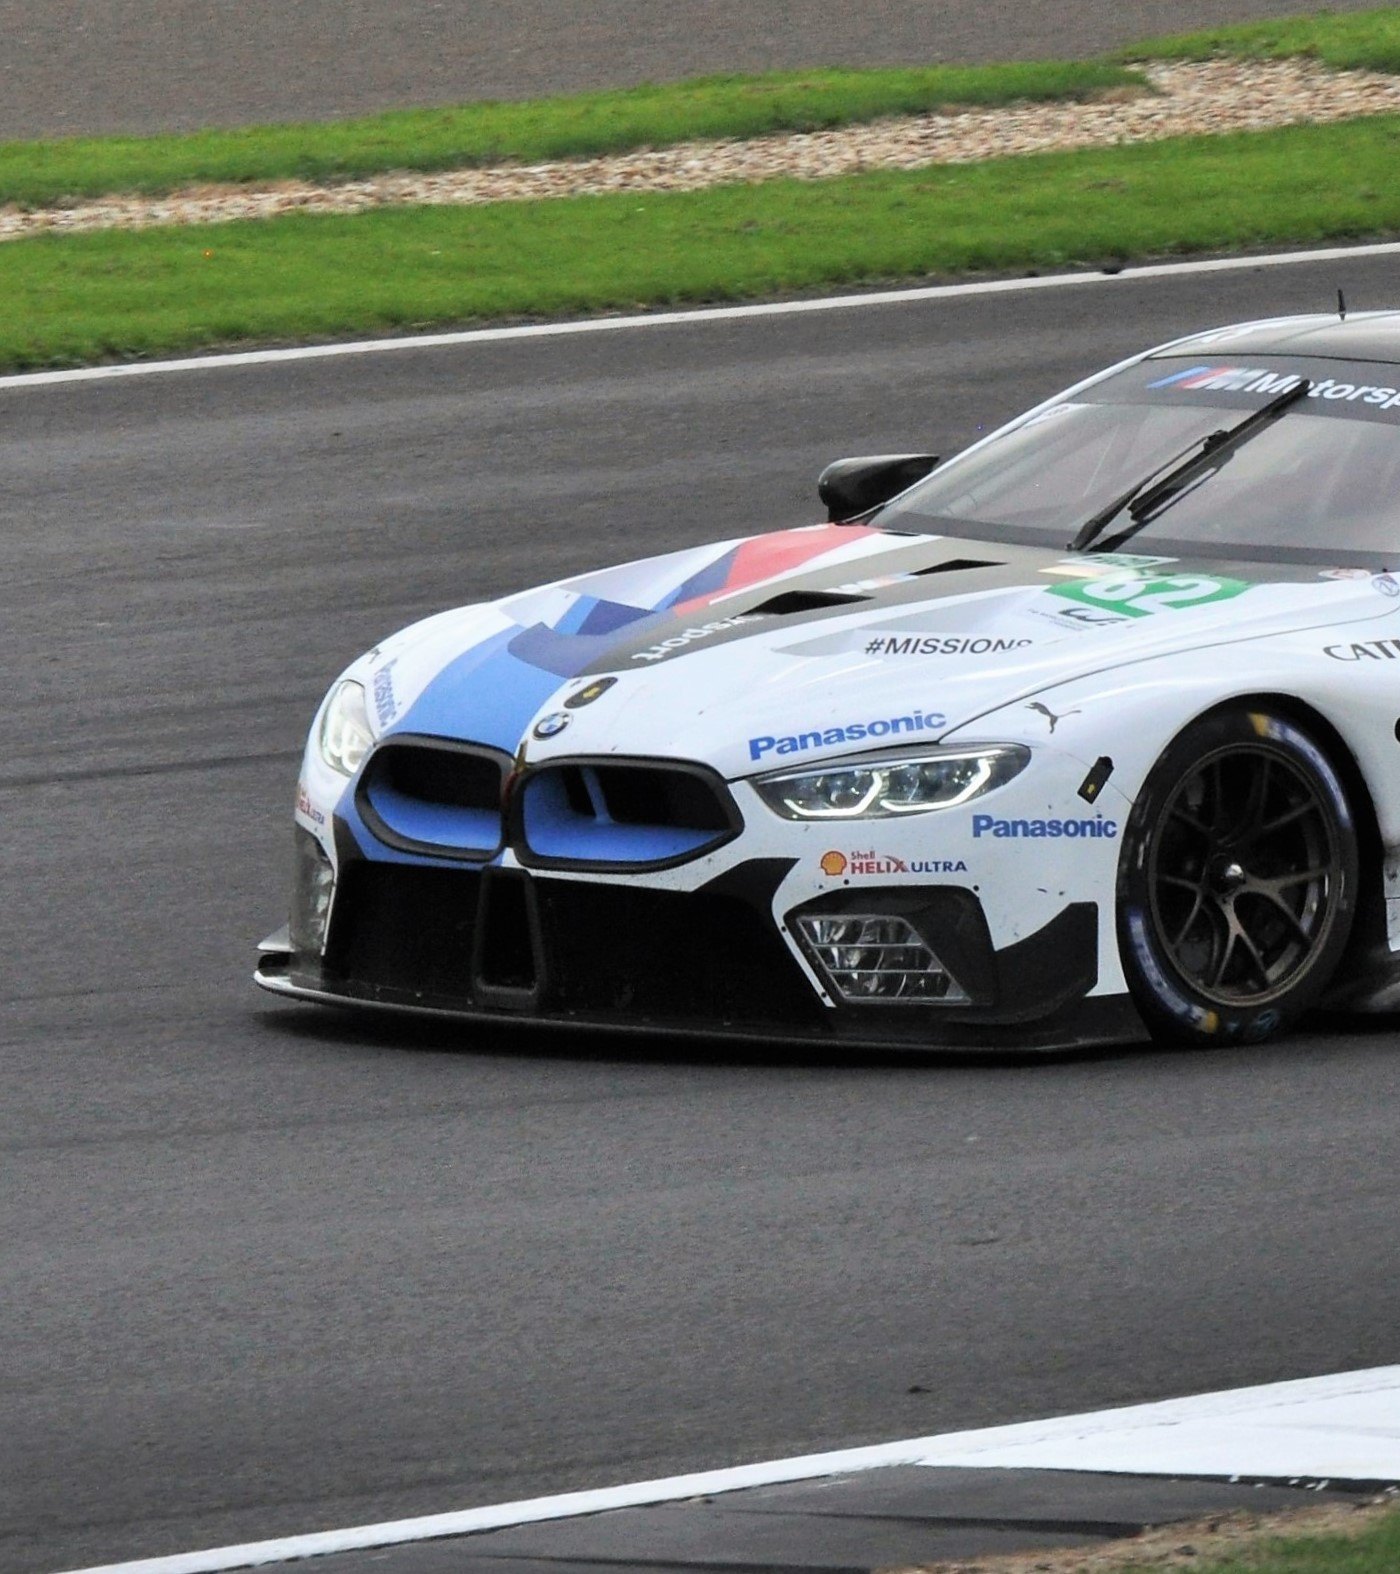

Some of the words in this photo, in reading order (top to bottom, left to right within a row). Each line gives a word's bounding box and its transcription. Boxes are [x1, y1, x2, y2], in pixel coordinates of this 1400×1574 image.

[748, 710, 947, 761] Panasonic
[972, 813, 1118, 839] Panasonic
[850, 850, 876, 861] Shell
[850, 855, 910, 875] HELIX
[911, 860, 968, 874] ULTRA
